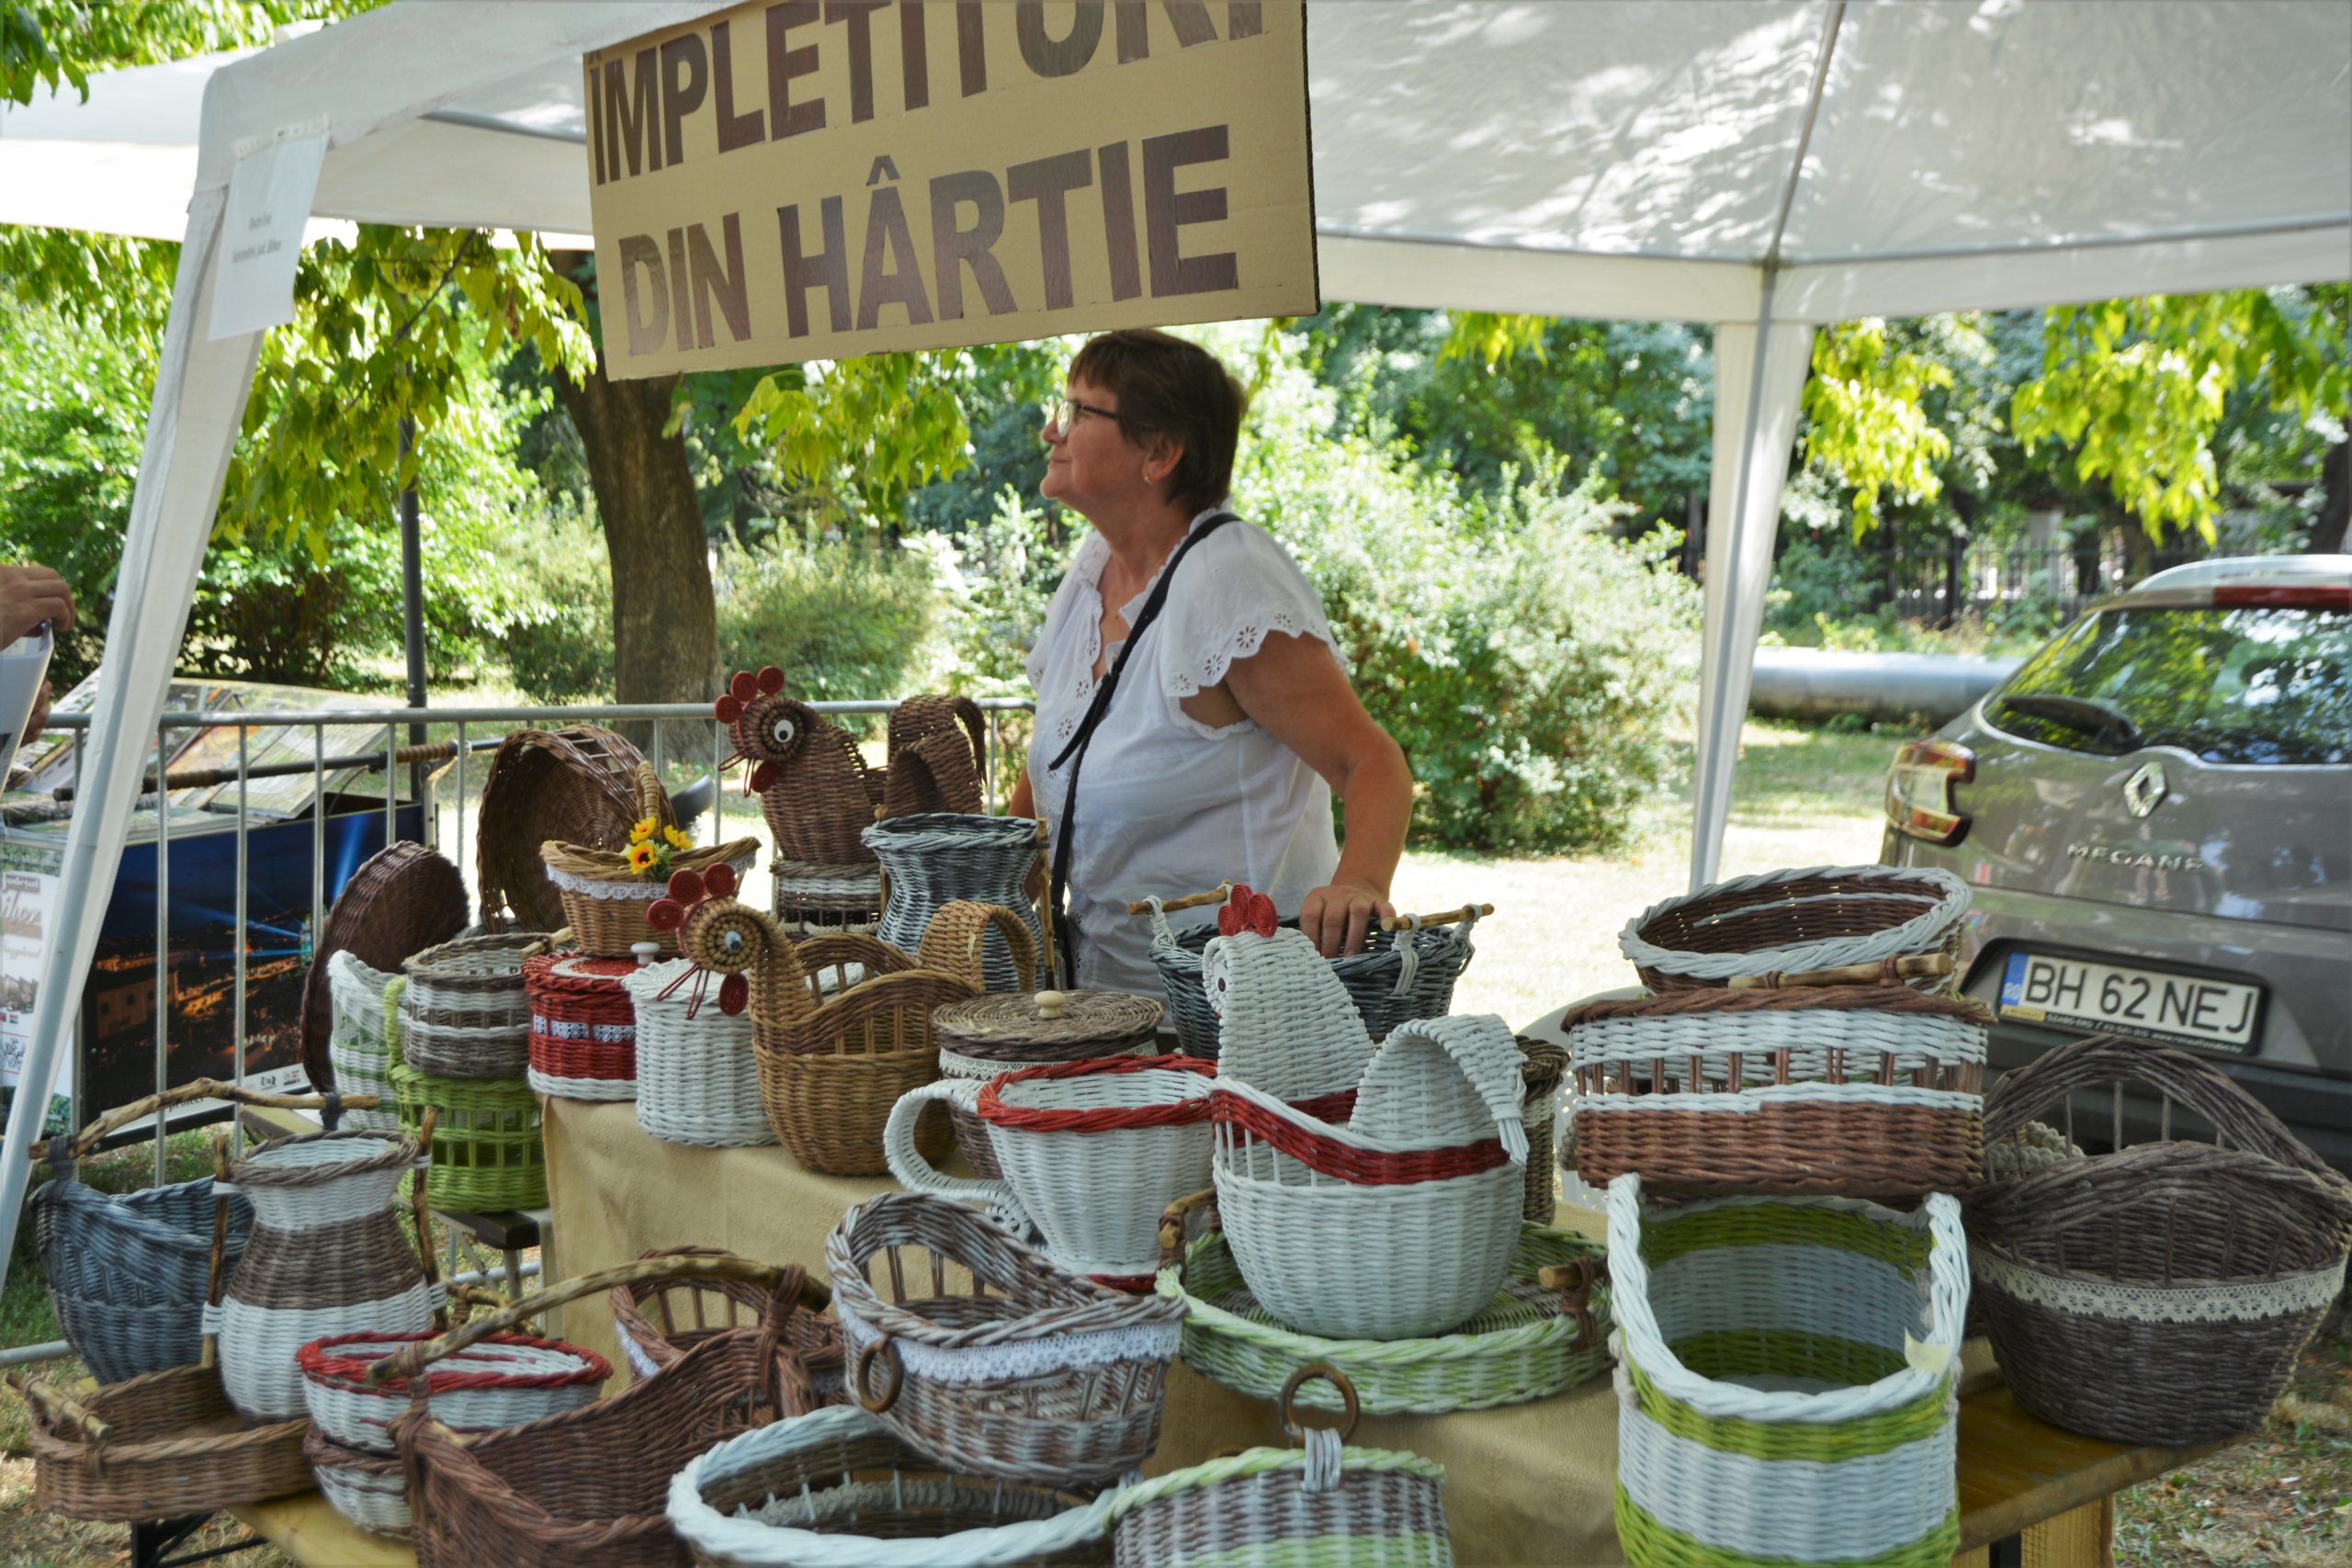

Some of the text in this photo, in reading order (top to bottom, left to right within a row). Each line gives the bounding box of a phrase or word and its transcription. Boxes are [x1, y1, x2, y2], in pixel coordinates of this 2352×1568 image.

[618, 124, 1238, 357] DIN HÂRTIE
[2067, 843, 2204, 870] MEGANE
[2025, 962, 2087, 1010] BH
[2099, 974, 2151, 1020] 62
[2159, 981, 2254, 1034] NEJ
